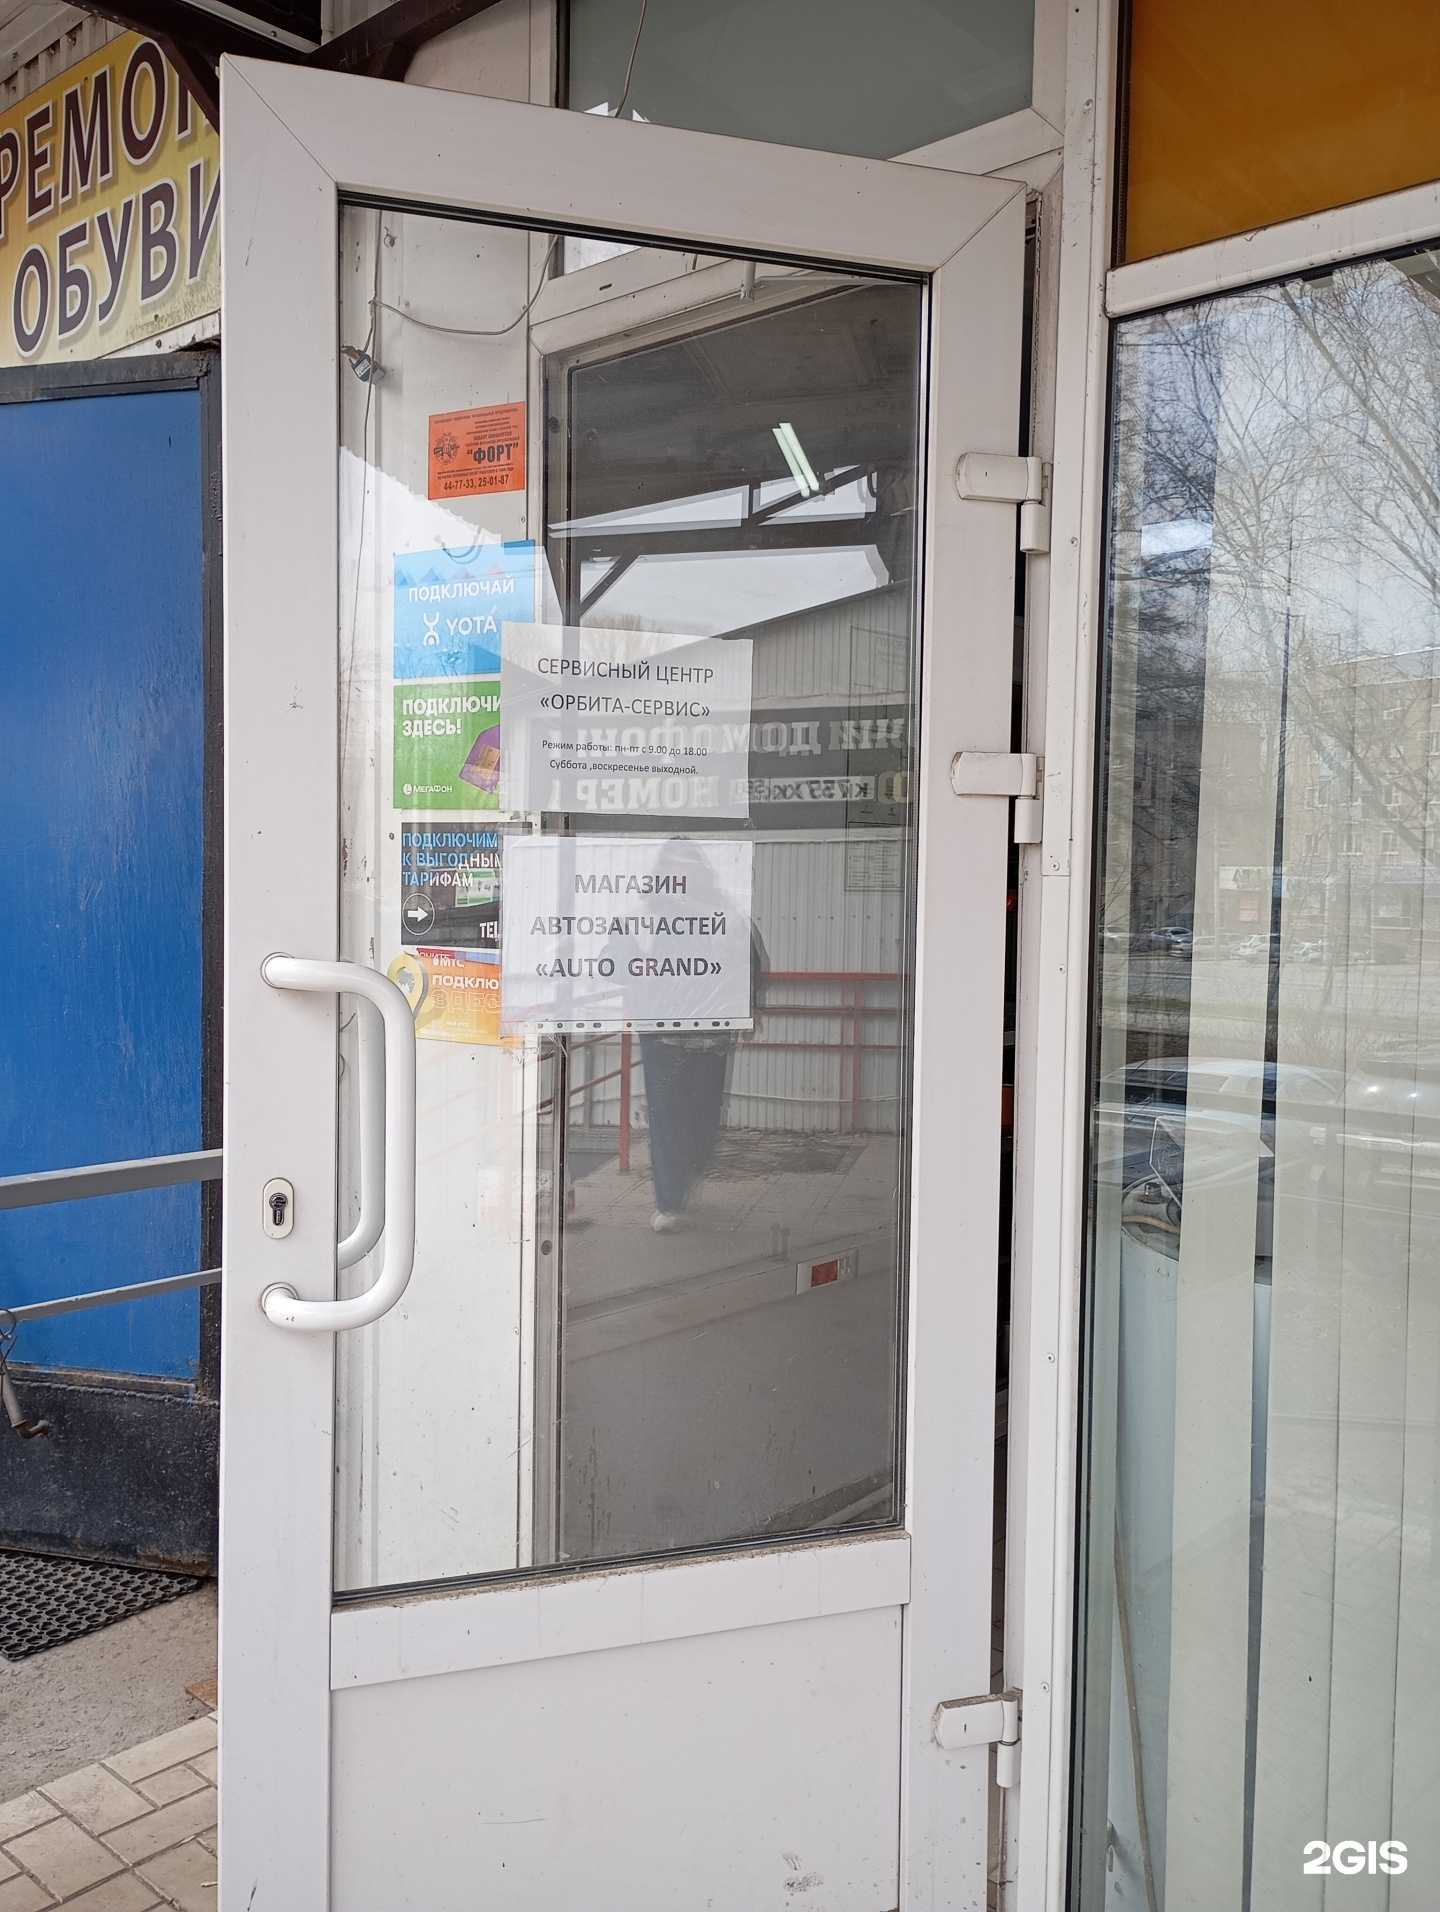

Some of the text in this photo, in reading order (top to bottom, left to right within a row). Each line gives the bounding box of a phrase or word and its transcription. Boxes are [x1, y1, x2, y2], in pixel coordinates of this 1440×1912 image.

[408, 575, 515, 603] ПОДКЛЮЧАЙ
[537, 657, 714, 685] СЕРВИСНЫЙ ЦЕНТР
[540, 694, 710, 717] «ОРБИТА-СЕРВИС»
[402, 718, 462, 738] ЗДЕСЬ!
[542, 740, 574, 751] Режим
[575, 741, 612, 755] работы:
[614, 745, 639, 753] пн-пт
[649, 745, 667, 754] 9.00
[669, 748, 681, 757] до
[684, 746, 708, 756] 18.00
[549, 759, 587, 771] Суббота
[652, 765, 698, 775] выходной.
[413, 785, 453, 793] МЕГАФОН
[402, 832, 498, 850] ПОДКЛЮЧИМ
[403, 853, 412, 866] К
[402, 871, 473, 887] ТАРИФАМ
[575, 874, 688, 895] МАГАЗИН
[530, 911, 727, 936] АВТОЗАПЧАСТЕЙ
[536, 957, 722, 977] «AUTO GRAND»
